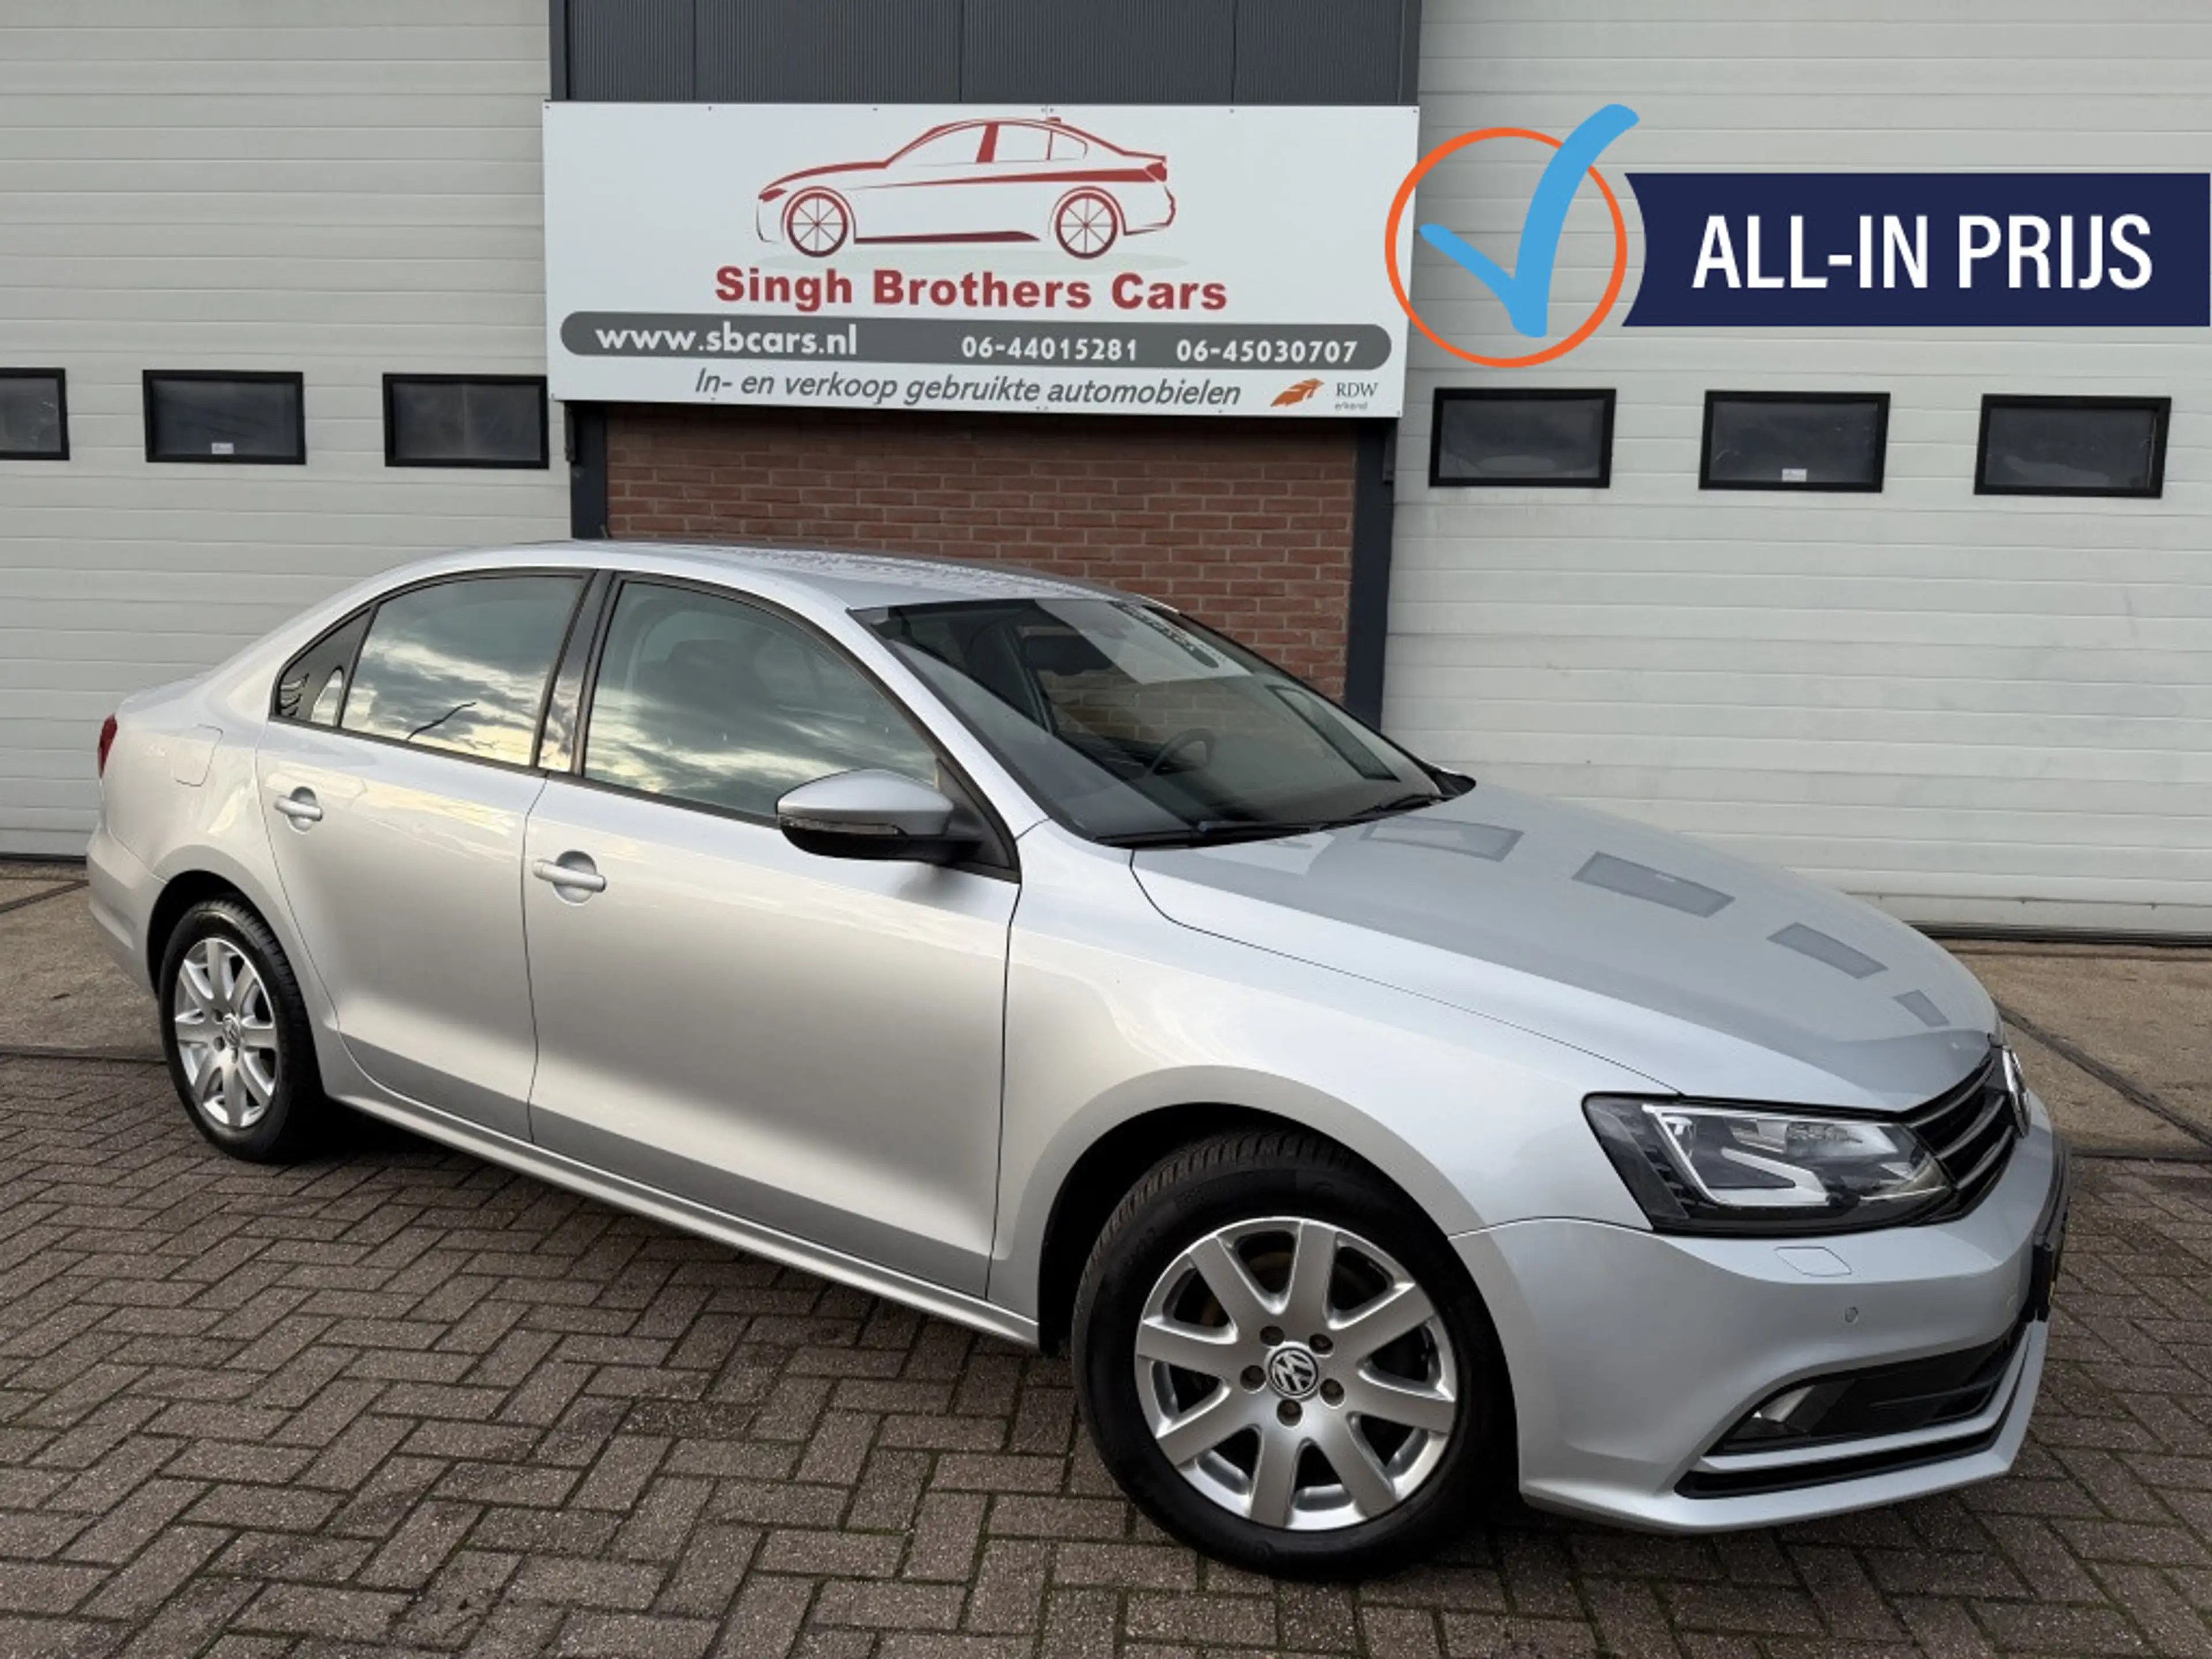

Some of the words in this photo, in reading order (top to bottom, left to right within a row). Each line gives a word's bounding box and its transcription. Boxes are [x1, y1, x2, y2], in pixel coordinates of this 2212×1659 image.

[715, 266, 852, 312] Singh
[874, 269, 1092, 309] Brothers
[1111, 272, 1228, 310] Cars
[596, 321, 858, 355] www.sbcars.nl
[961, 335, 1137, 361] 06-44015281
[1176, 339, 1358, 363] 06-45030707
[695, 368, 733, 394] In-
[741, 376, 774, 395] en
[785, 371, 898, 405] verkoop
[904, 374, 1040, 406] gebruikte
[1047, 378, 1241, 406] automobielen
[1336, 382, 1378, 397] RDW
